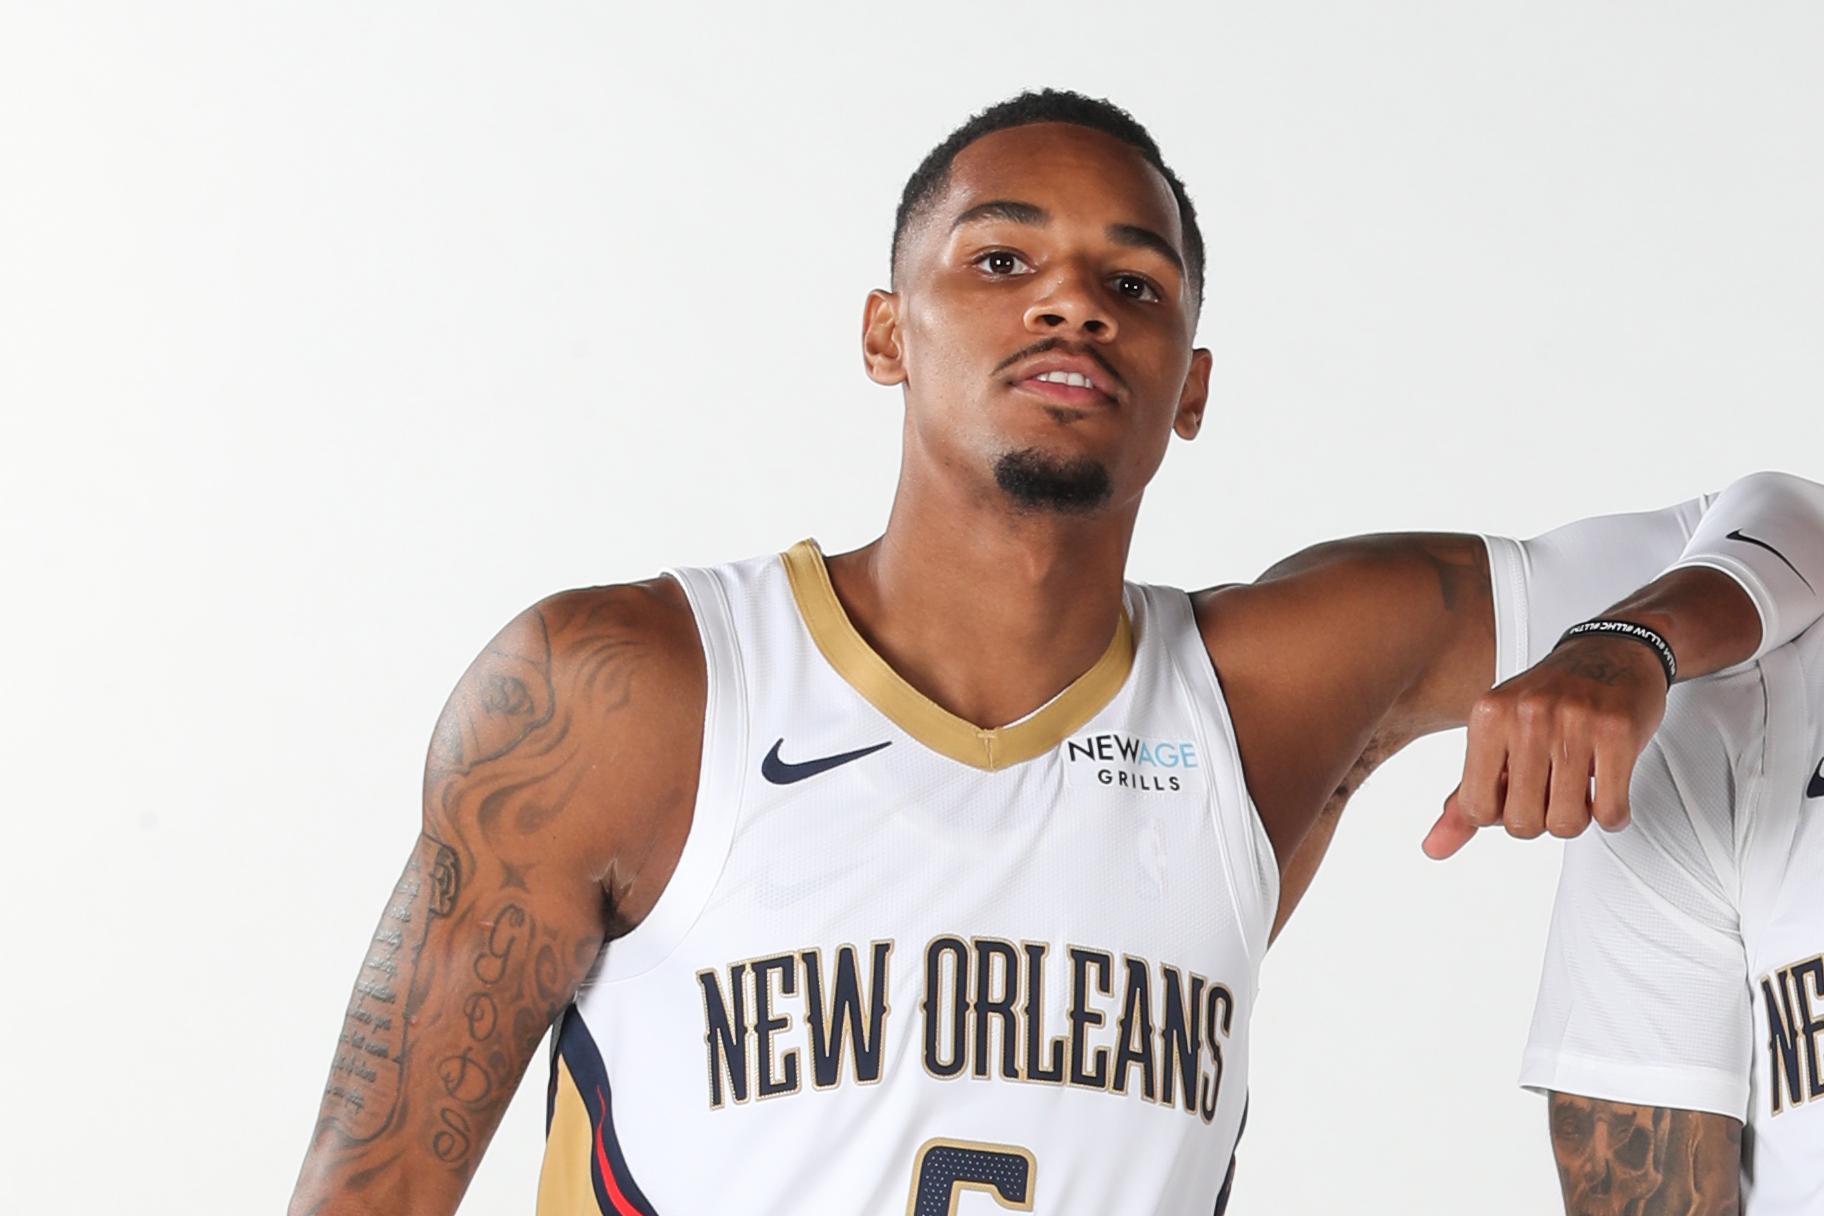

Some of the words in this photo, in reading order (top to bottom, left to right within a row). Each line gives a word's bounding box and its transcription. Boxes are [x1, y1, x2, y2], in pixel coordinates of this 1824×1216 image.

[1097, 768, 1182, 792] GRILLS
[695, 938, 895, 1112] NEW
[921, 934, 1235, 1126] ORLEANS
